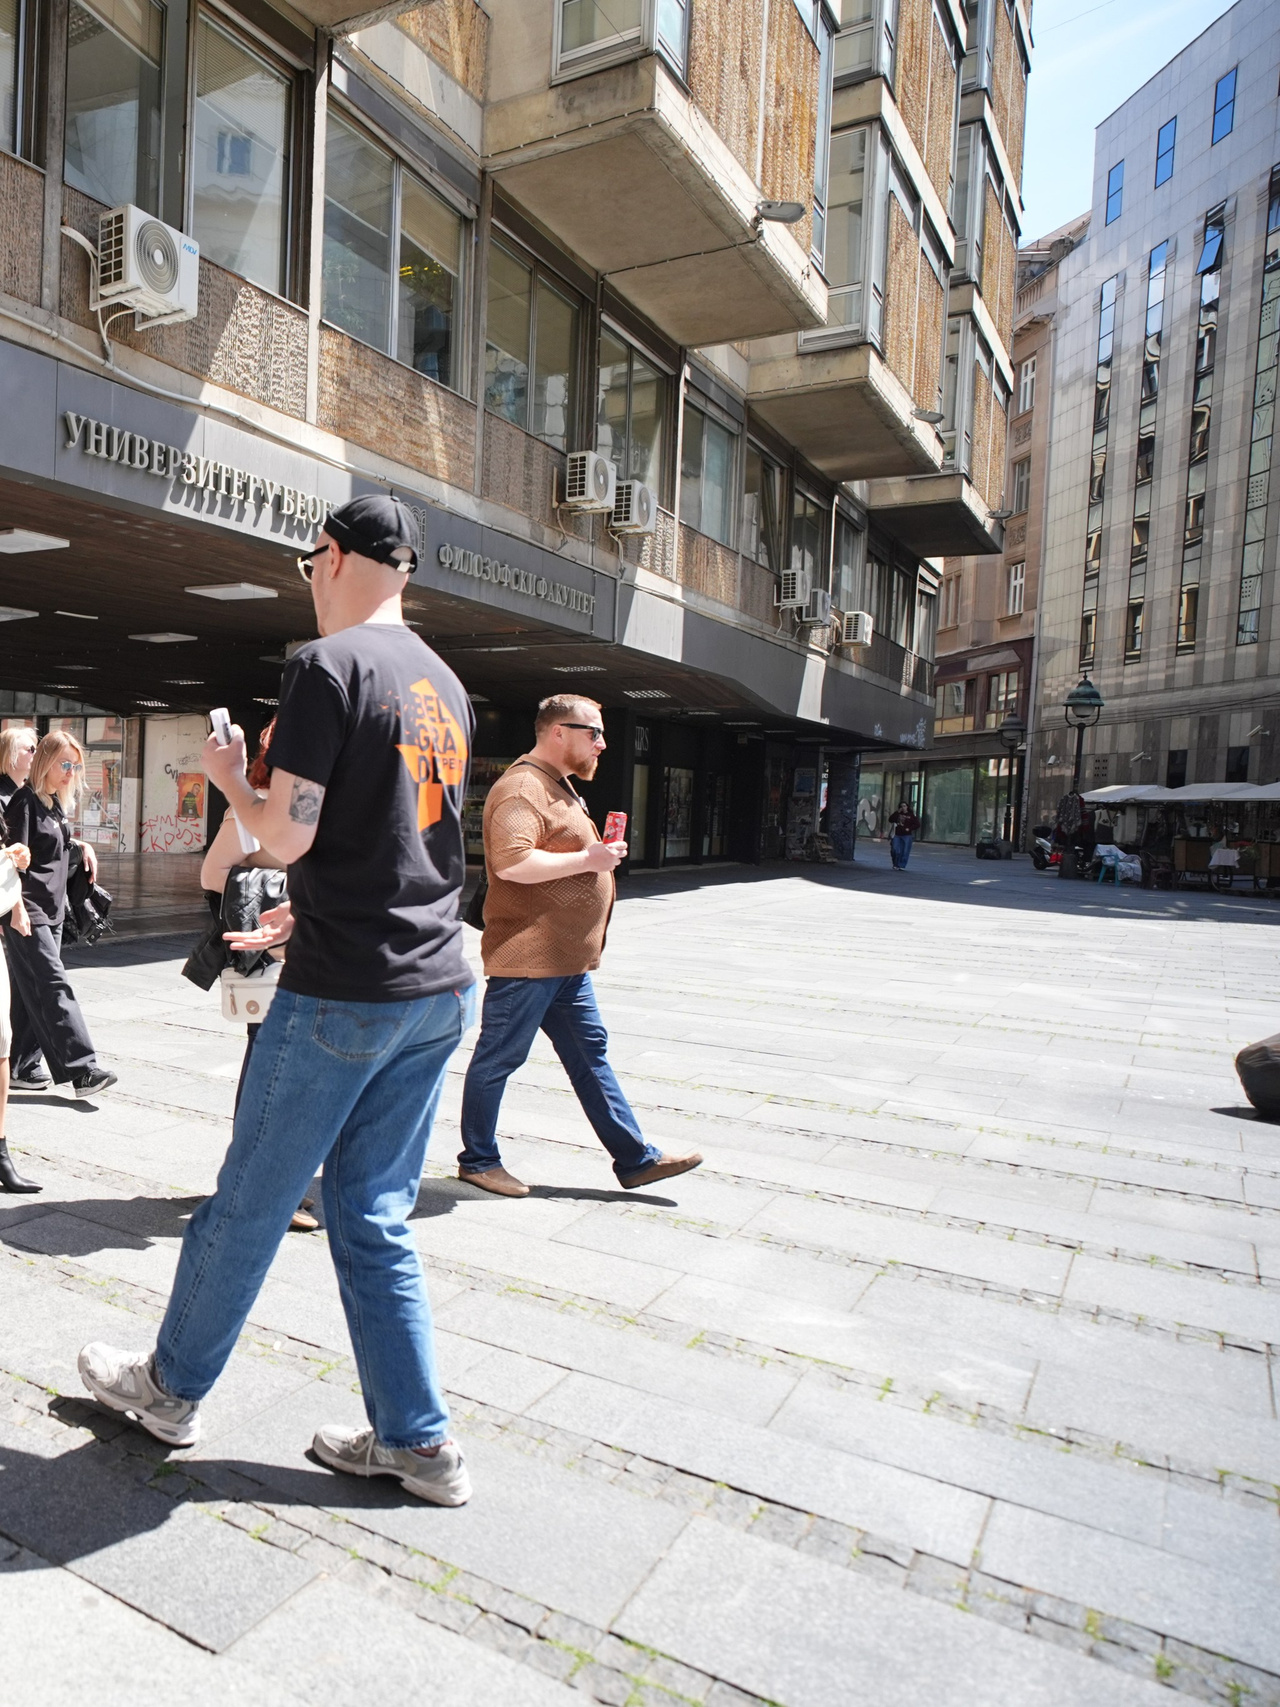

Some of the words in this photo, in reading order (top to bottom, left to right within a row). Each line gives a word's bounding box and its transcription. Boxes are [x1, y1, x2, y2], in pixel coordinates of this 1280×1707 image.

[64, 410, 260, 505] УНИВЕРЗИТЕТ
[438, 543, 537, 598] ФИЛОЗОФСКИ
[536, 577, 596, 616] ФАКУЛТЕТ
